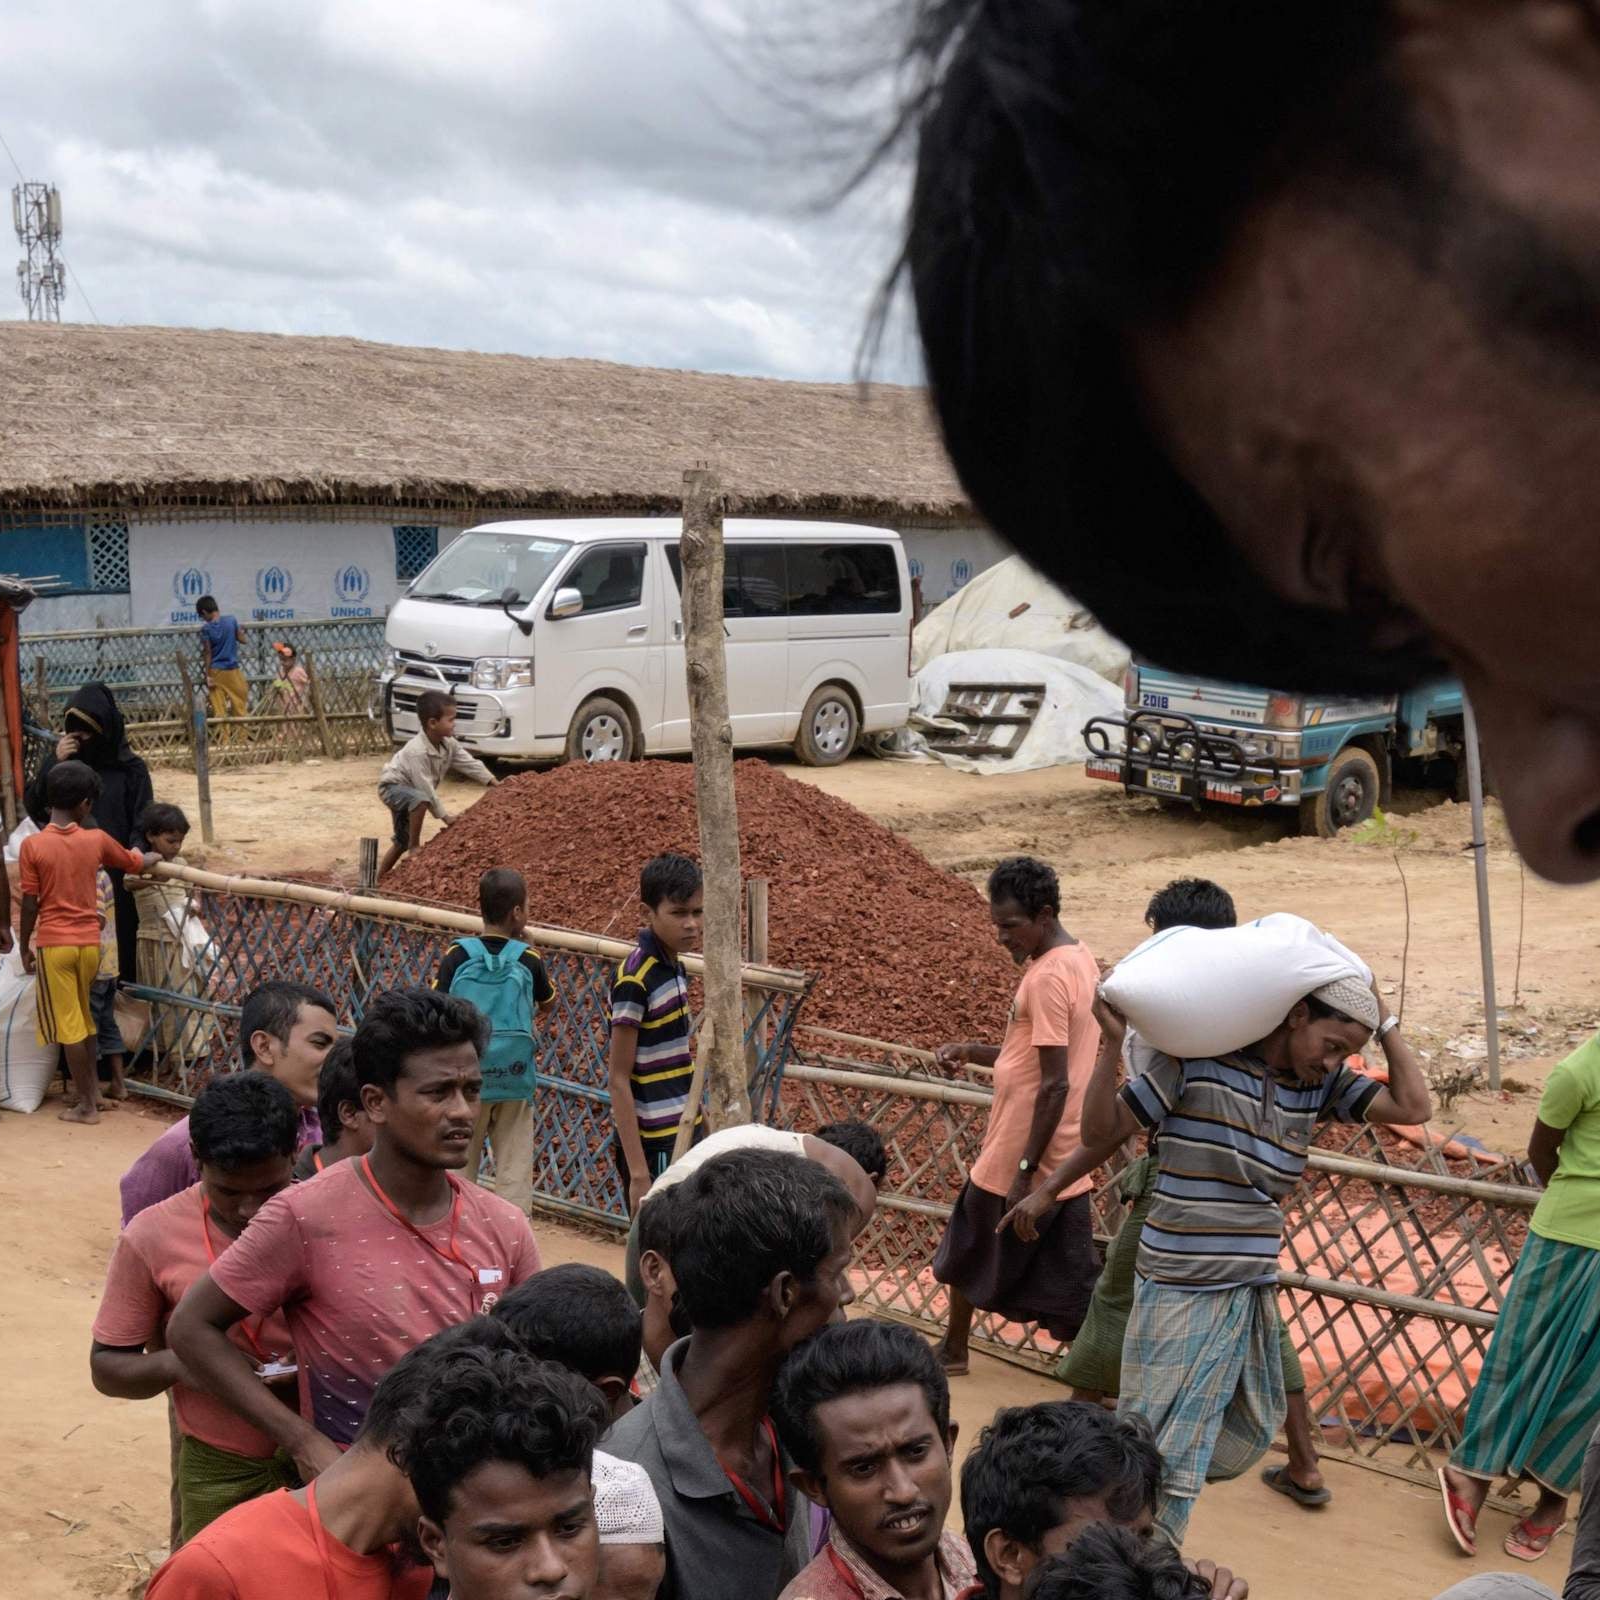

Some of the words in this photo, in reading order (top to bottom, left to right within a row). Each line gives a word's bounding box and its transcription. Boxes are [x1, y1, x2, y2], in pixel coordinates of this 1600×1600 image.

[171, 611, 201, 623] UNH
[252, 608, 294, 620] UNHCR
[331, 607, 372, 617] UNHCR
